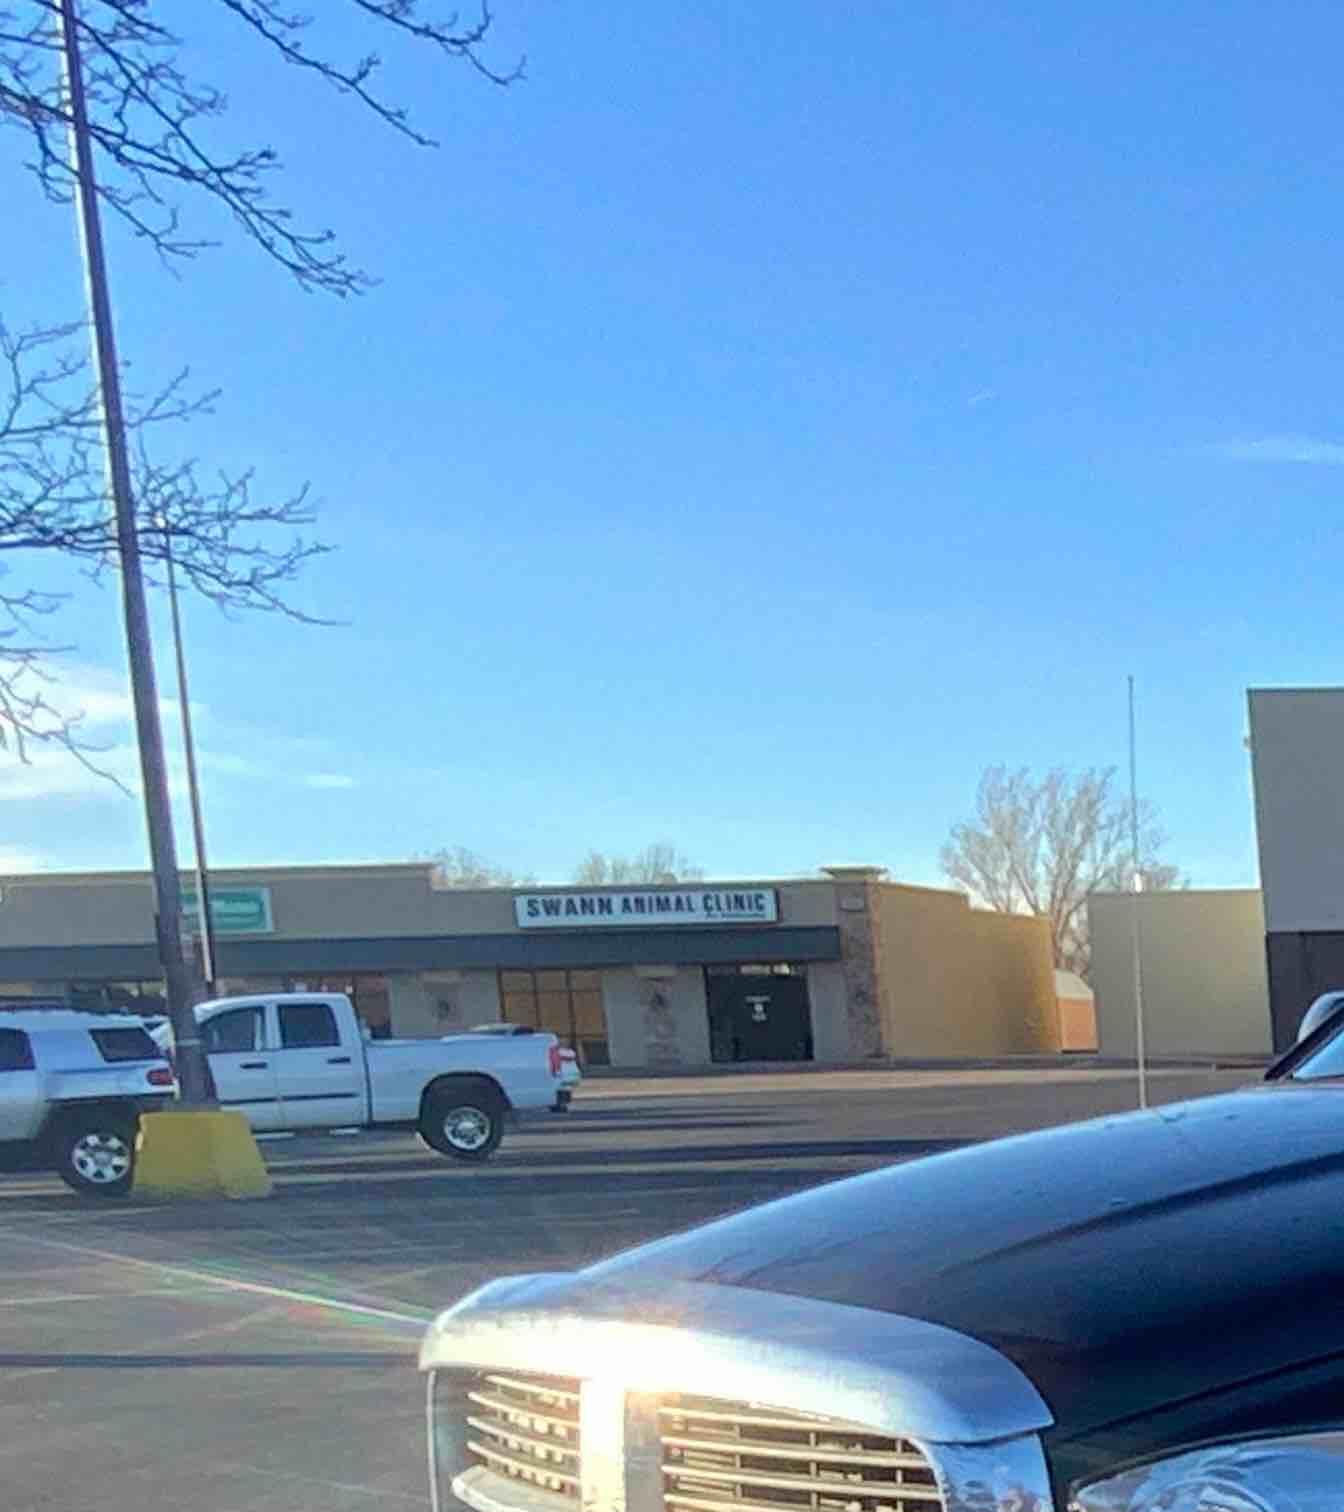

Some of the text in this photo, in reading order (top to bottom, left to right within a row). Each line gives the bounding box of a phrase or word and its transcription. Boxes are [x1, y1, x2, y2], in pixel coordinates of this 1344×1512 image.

[526, 896, 613, 918] SWANN
[621, 894, 696, 914] ANIMAL
[703, 892, 766, 911] CLINIC
